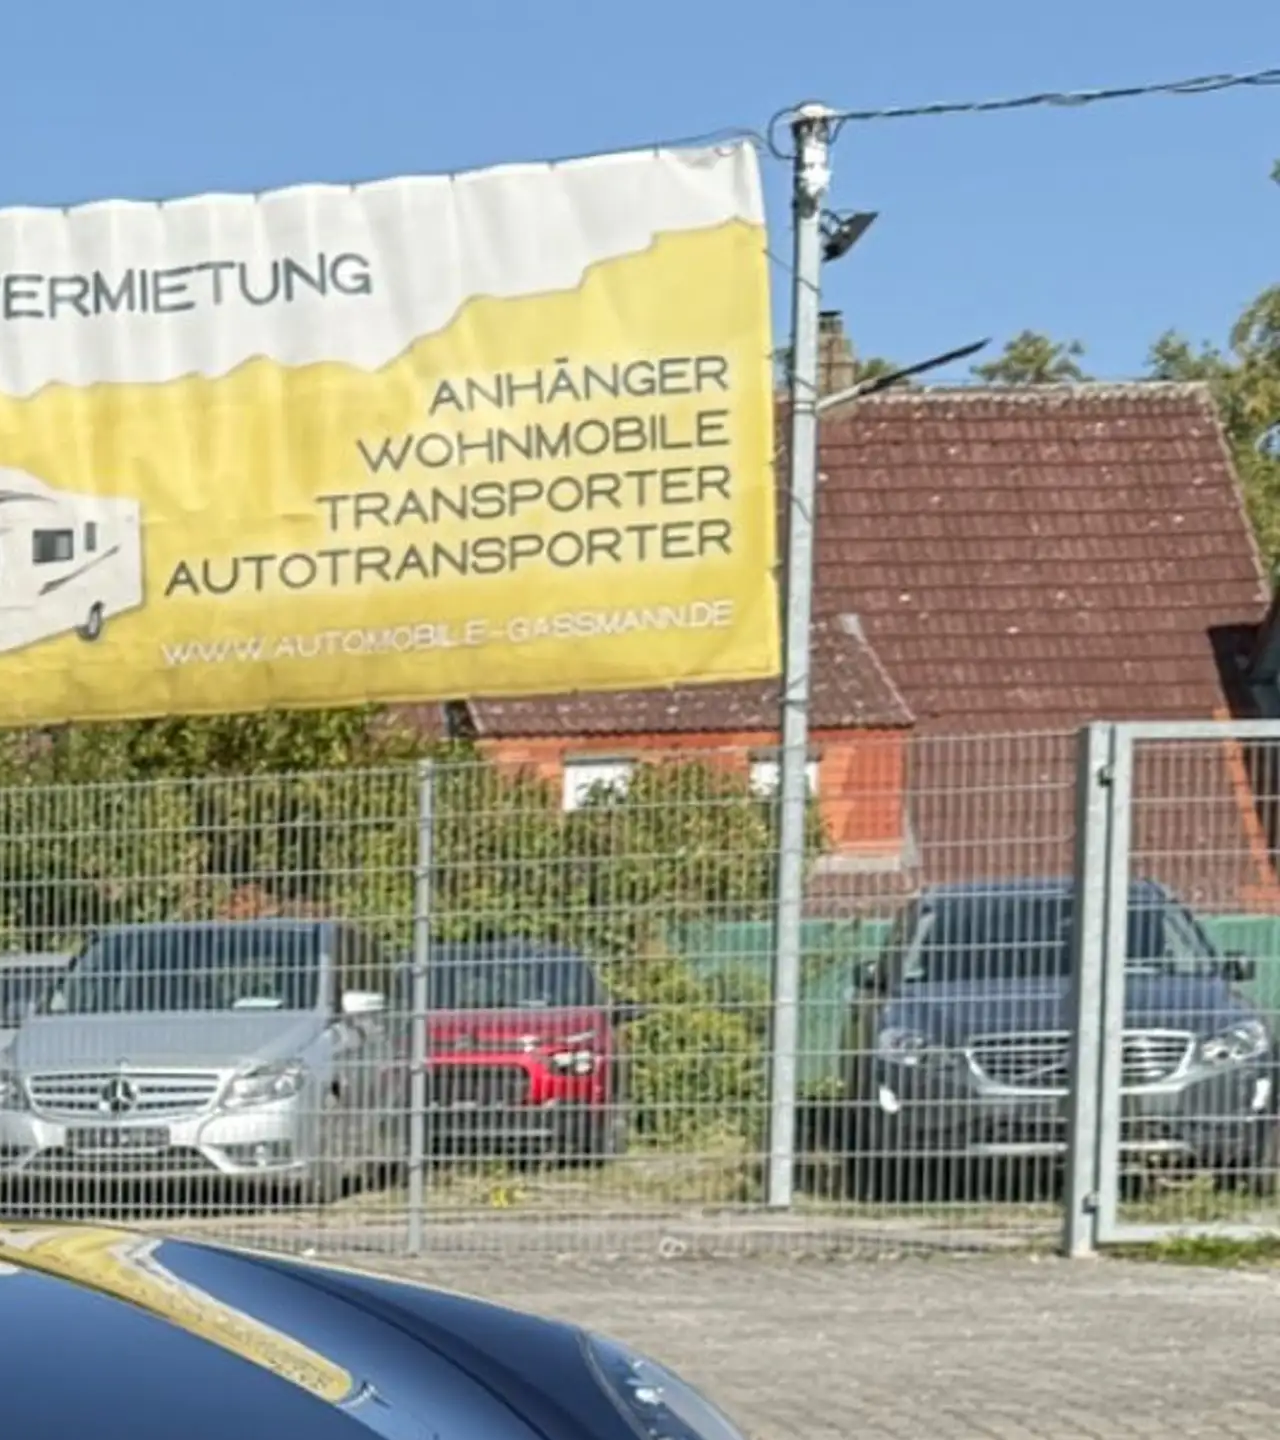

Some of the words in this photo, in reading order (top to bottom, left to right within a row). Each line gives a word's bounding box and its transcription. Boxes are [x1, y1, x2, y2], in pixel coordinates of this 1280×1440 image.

[428, 355, 729, 417] ANHÄNGER
[356, 409, 730, 475] WOHNMOBILE
[317, 464, 732, 532] TRANSPORTER
[164, 518, 733, 598] AUTOTRANSPORTER
[160, 599, 734, 667] WWW.AUTOMOBILE-GASSMANN.DE
